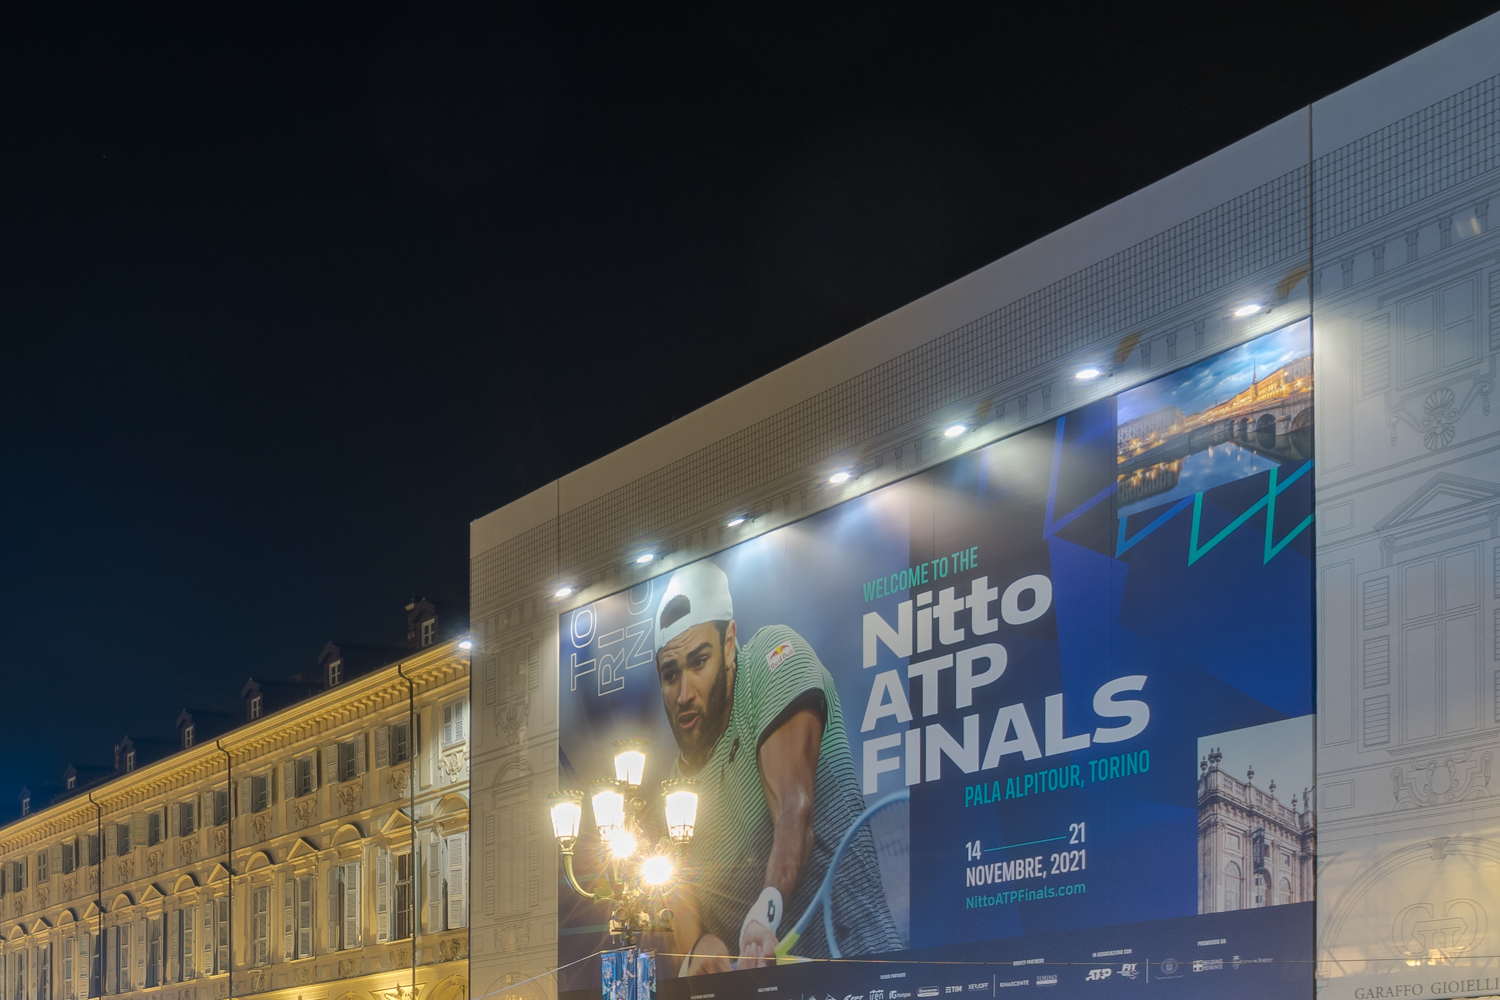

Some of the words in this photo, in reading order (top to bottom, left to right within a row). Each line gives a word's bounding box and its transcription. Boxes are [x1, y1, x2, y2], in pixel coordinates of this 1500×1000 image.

[862, 561, 929, 603] WELCOME
[931, 556, 949, 581] TO
[951, 545, 979, 574] THE
[862, 573, 1053, 670] Nitto
[860, 642, 1008, 734] ATP
[862, 674, 1151, 796] FINALS
[964, 780, 1002, 808] PALA
[1005, 763, 1086, 800] ALPITOUR,
[1088, 749, 1151, 783] TORINO
[965, 840, 982, 862] 14
[1068, 821, 1086, 845] 21
[965, 855, 1048, 888] NOVEMBRE,
[1050, 849, 1087, 875] 2021
[965, 883, 1087, 910] NittoATPFinals.com
[1085, 968, 1112, 982] ATP
[1354, 983, 1423, 1000] GARAFFO
[1430, 977, 1500, 995] GIOIELLI
